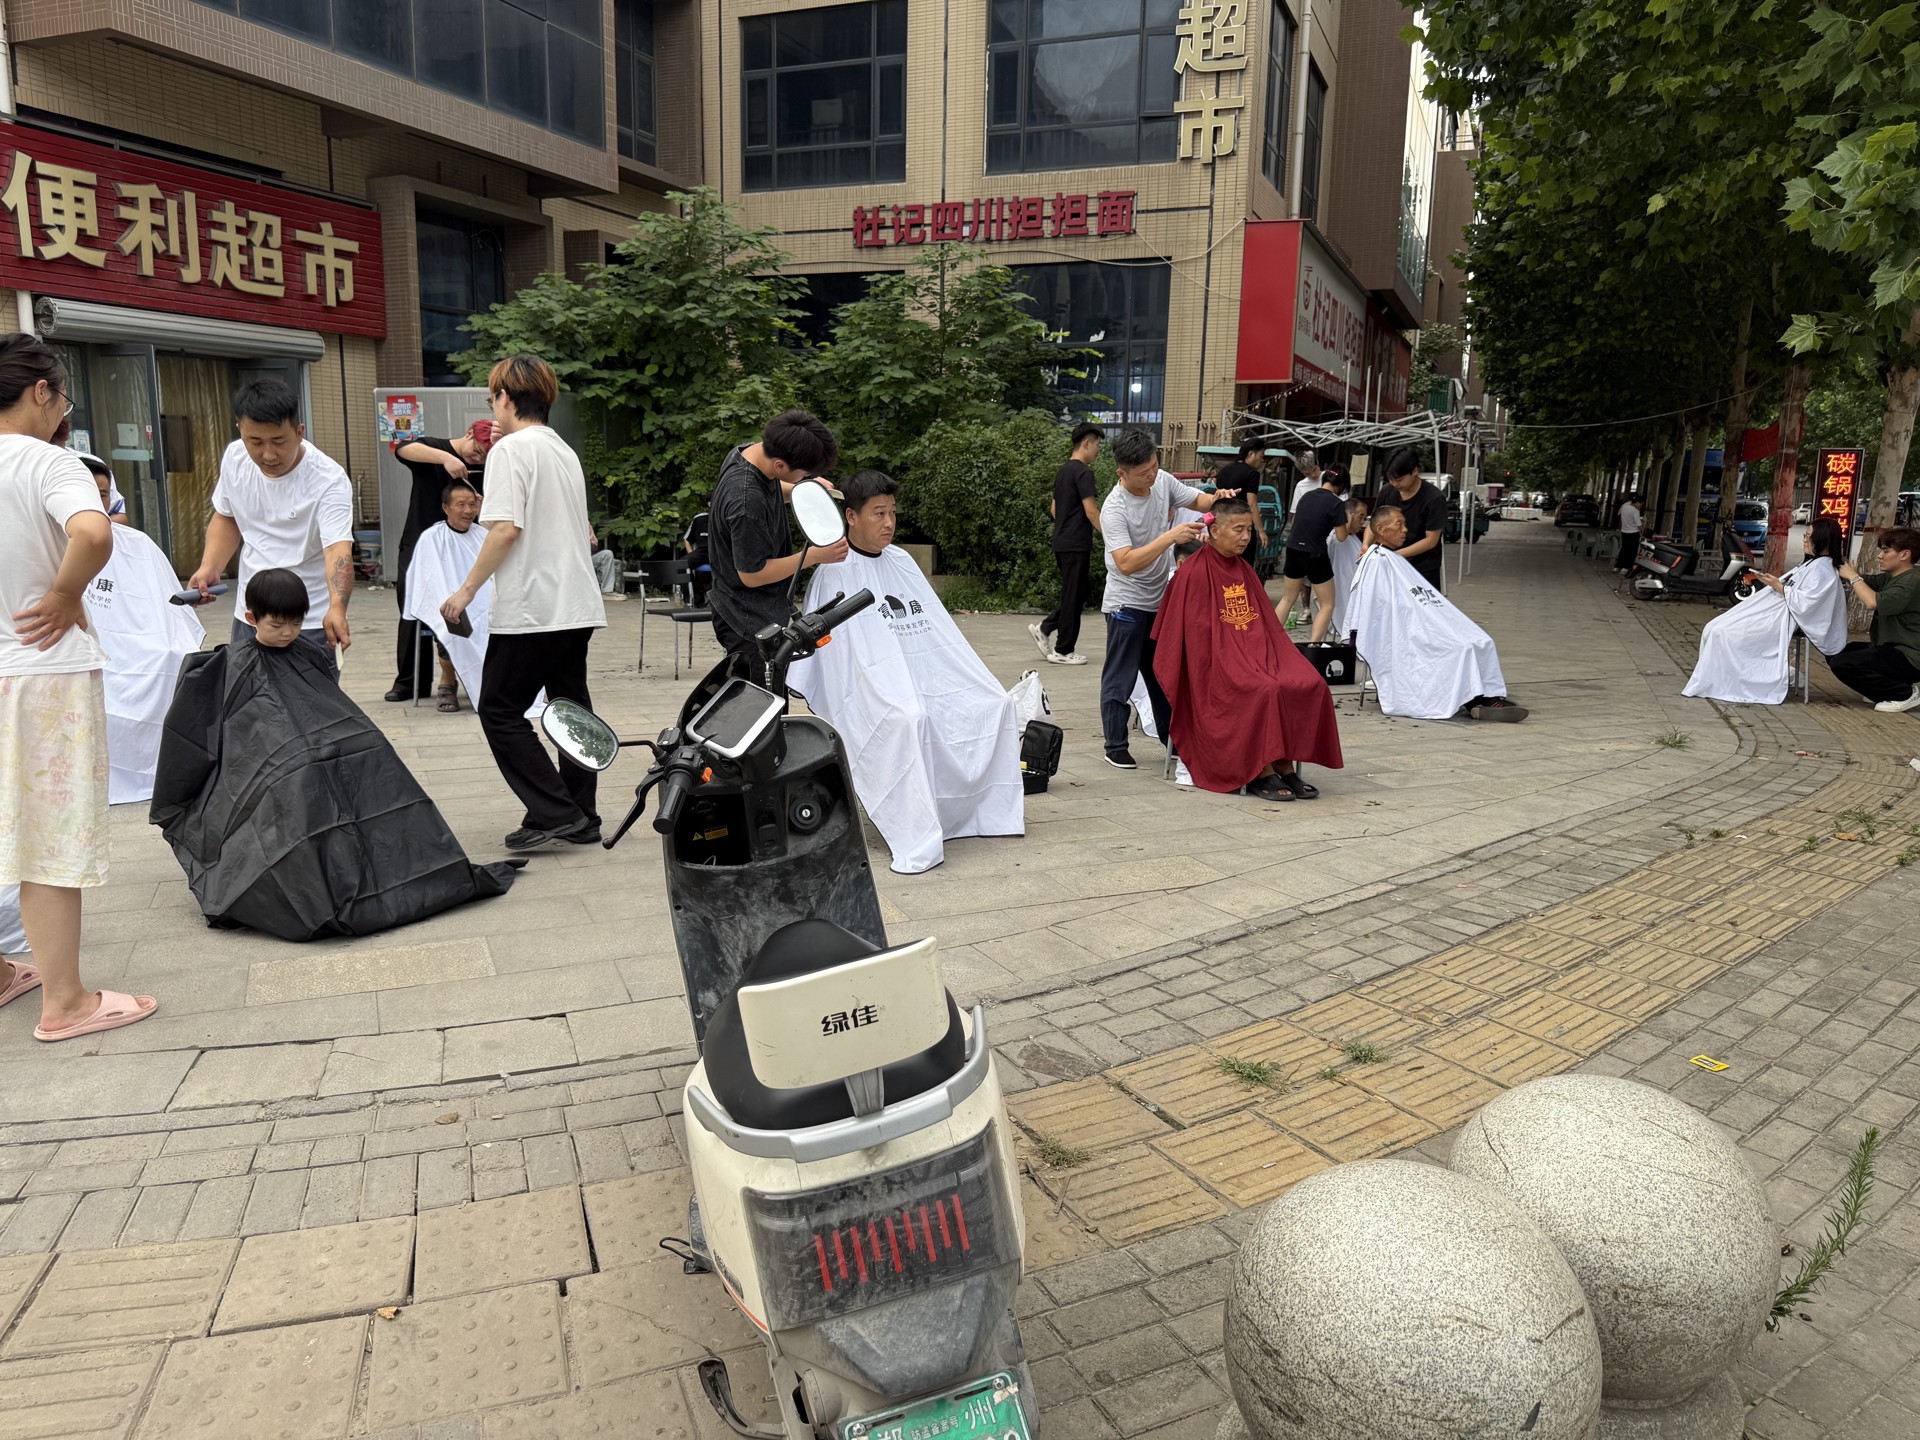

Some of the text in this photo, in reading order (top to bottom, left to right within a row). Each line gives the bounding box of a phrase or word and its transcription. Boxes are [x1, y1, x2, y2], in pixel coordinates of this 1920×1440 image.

[1174, 0, 1248, 164] 超市
[1, 150, 360, 307] 便利超市
[852, 190, 1136, 248] 杜记四川担担面
[96, 578, 114, 592] 康
[909, 600, 924, 615] 康
[821, 1004, 879, 1036] 绿佳
[964, 1395, 997, 1431] 州
